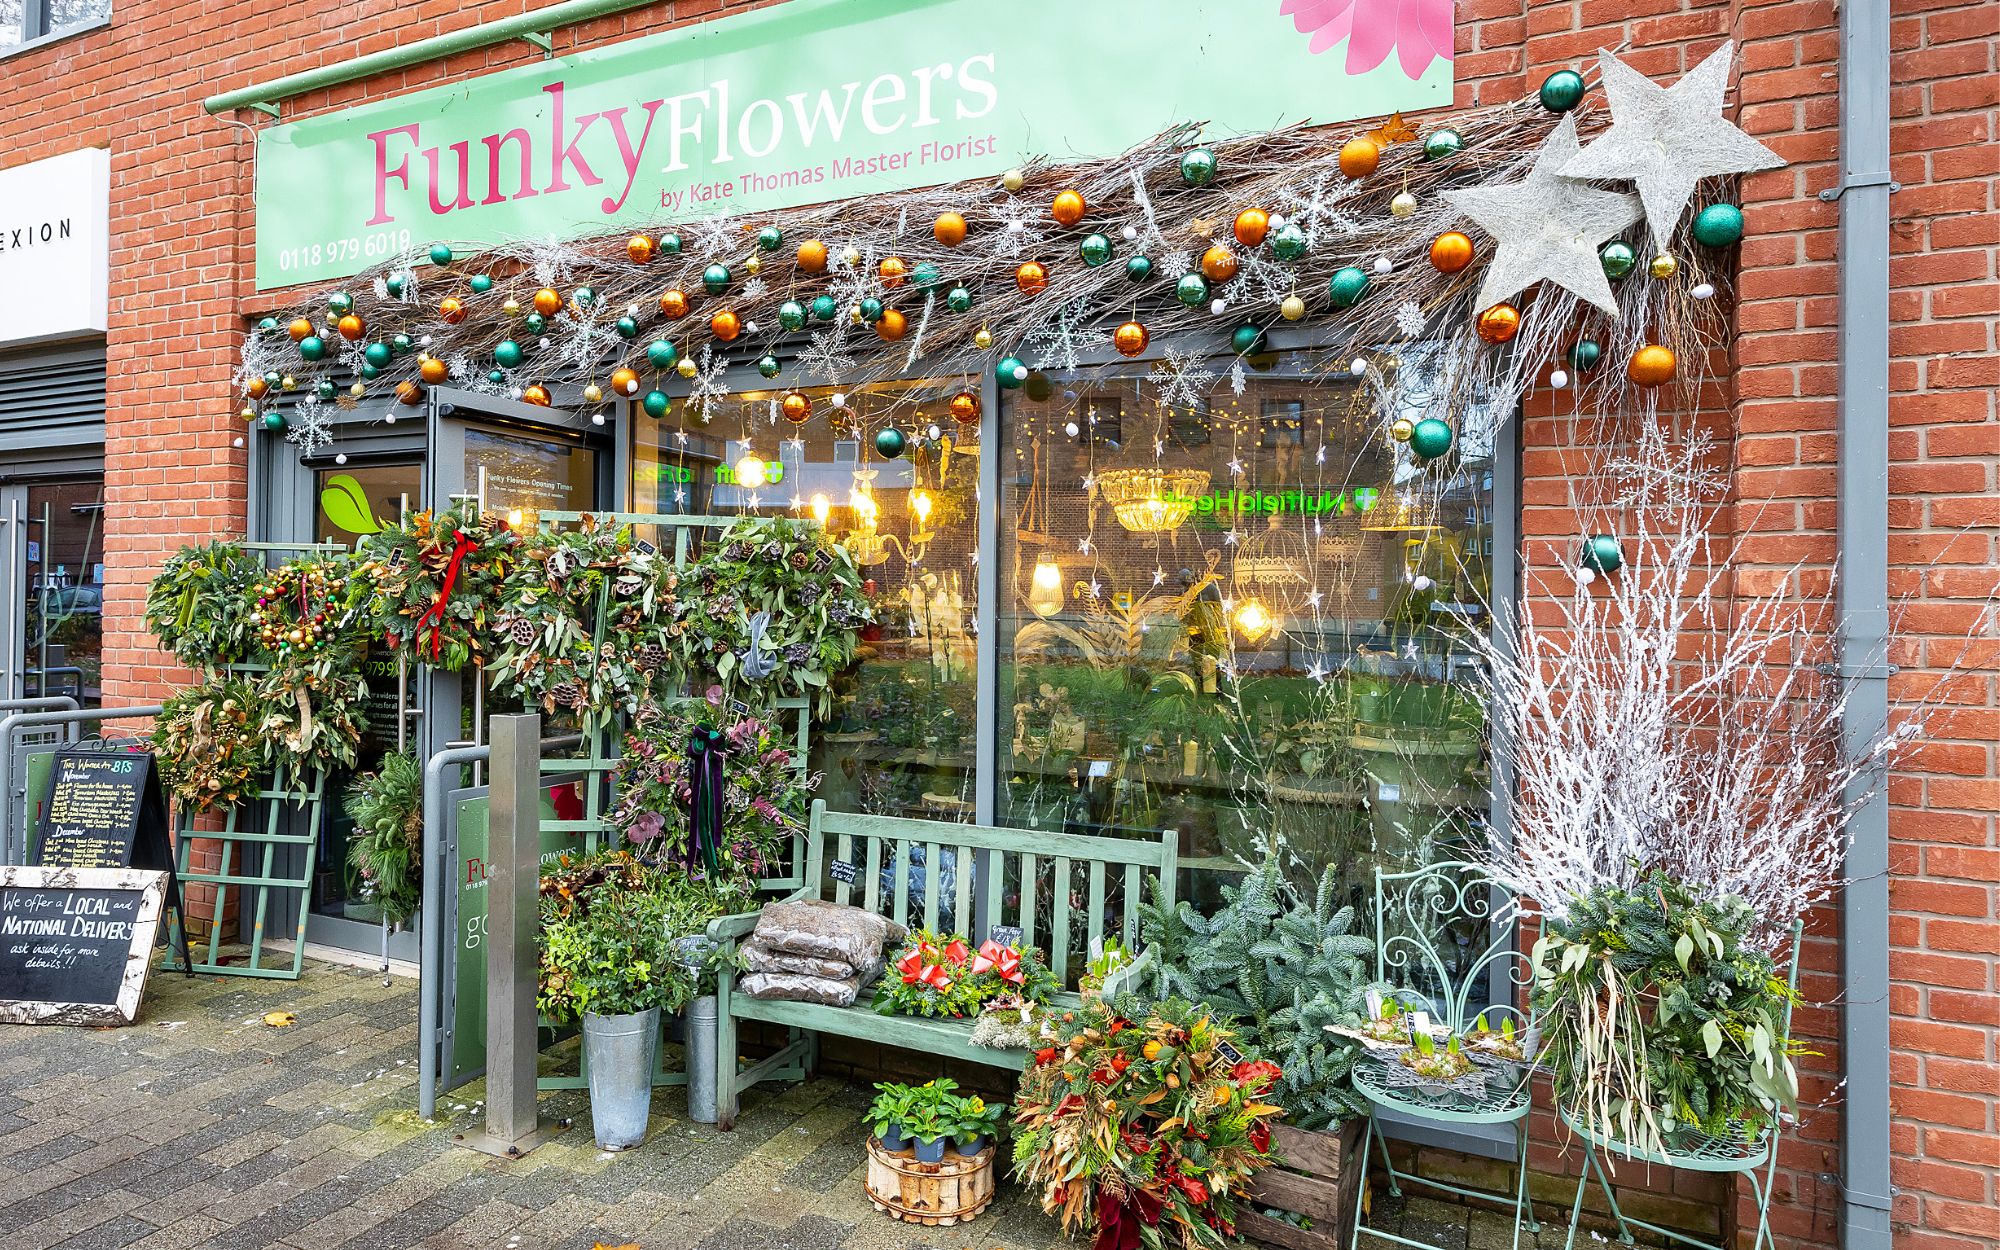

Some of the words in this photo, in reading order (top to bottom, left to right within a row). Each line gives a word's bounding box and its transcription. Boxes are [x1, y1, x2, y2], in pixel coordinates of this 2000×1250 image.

[366, 81, 664, 226] Funky
[662, 52, 998, 173] Flowers
[661, 189, 683, 212] by
[690, 181, 734, 203] Kate
[740, 164, 824, 194] Thomas
[832, 150, 912, 179] Master
[920, 134, 997, 165] Florist
[280, 244, 322, 271] 0118
[326, 238, 360, 263] 979
[364, 229, 411, 256] 6019
[506, 475, 529, 485] Flowers
[531, 480, 555, 491] Opening
[557, 482, 573, 492] Times
[63, 769, 90, 782] November
[111, 760, 133, 774] BFS
[52, 825, 85, 837] December
[466, 882, 479, 891] 0118
[3, 891, 20, 911] We
[25, 893, 54, 913] offer
[55, 900, 63, 908] a
[63, 893, 110, 915] LOCAL
[113, 900, 133, 910] and
[1, 915, 66, 935] NATIONAL
[70, 915, 135, 940] DELIVERY
[10, 942, 29, 954] ask
[33, 943, 58, 955] inside
[57, 943, 75, 958] for
[78, 948, 100, 957] more
